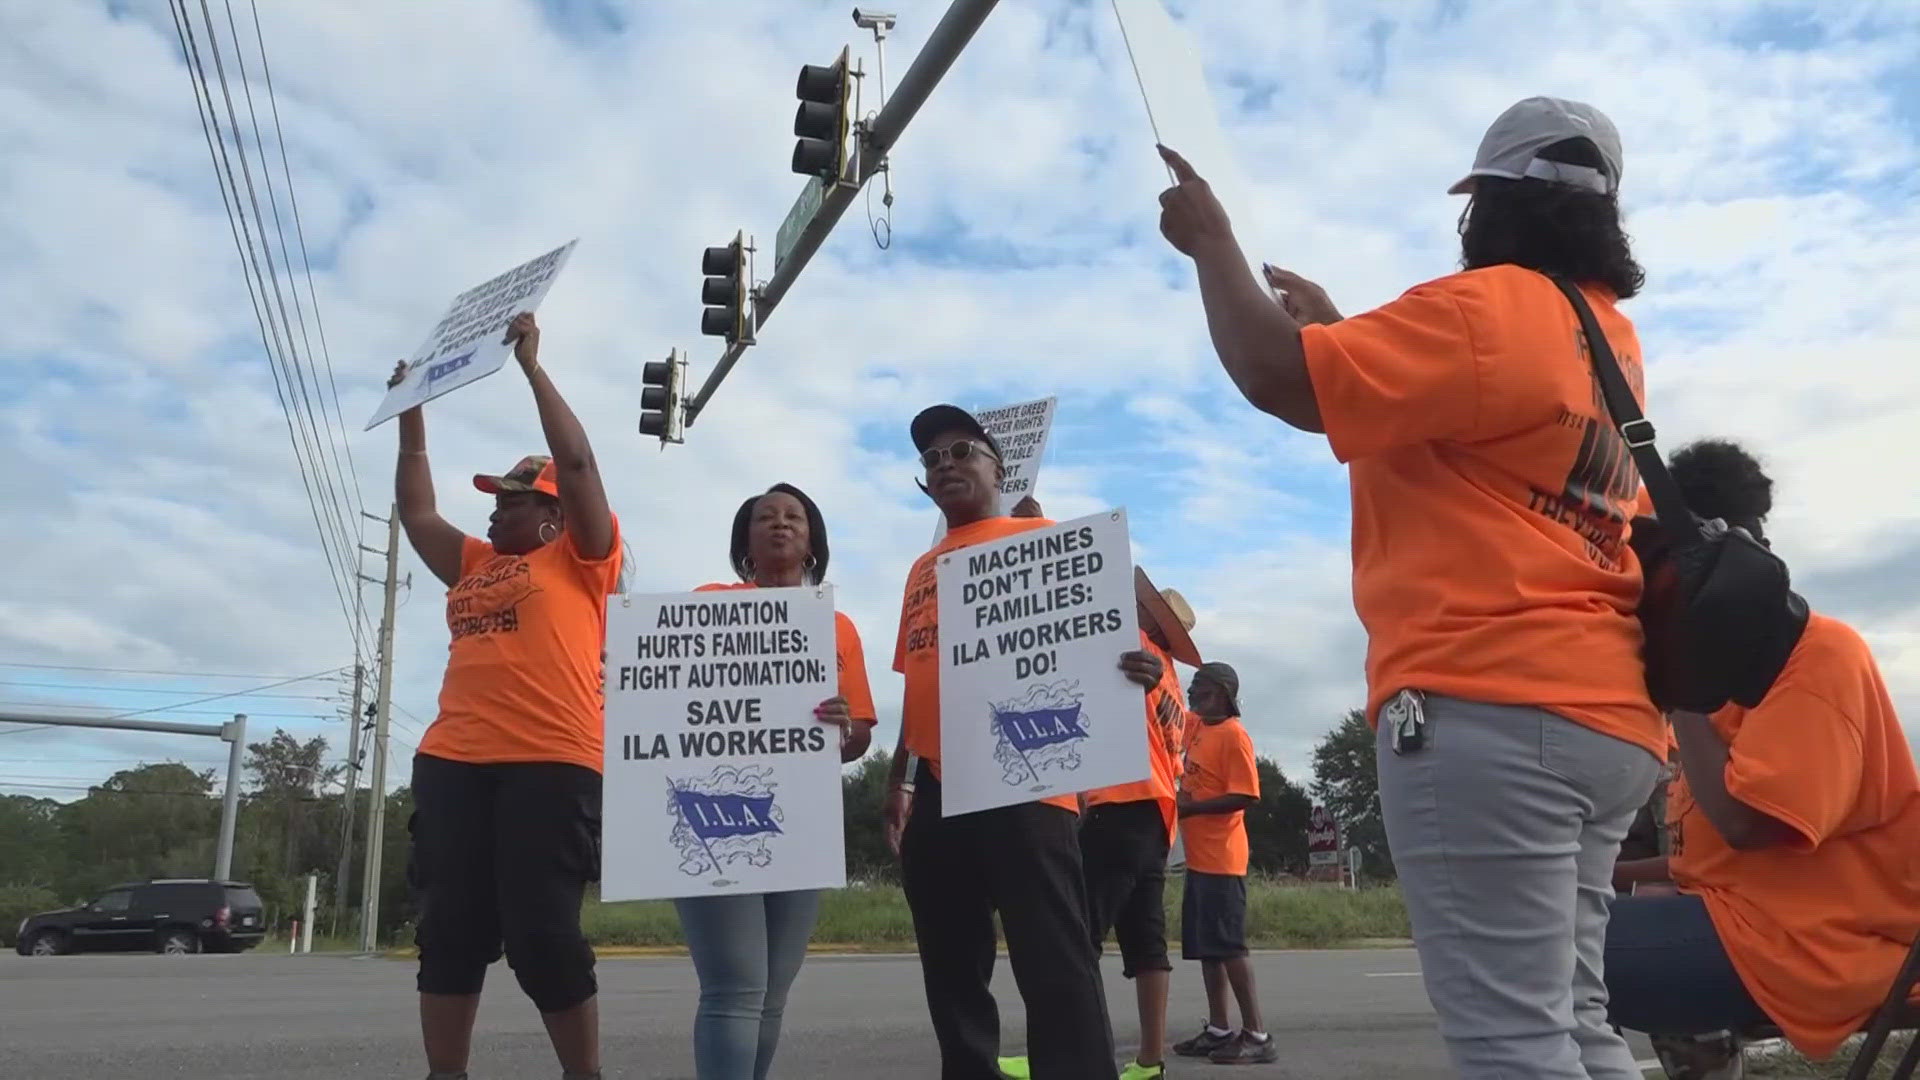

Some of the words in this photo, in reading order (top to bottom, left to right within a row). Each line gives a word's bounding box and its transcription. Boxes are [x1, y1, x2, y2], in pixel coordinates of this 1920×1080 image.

[1021, 401, 1048, 417] GREED
[1013, 431, 1043, 446] PEOPLE
[969, 526, 1094, 577] MACHINES
[963, 568, 1033, 605] DON'T
[1042, 552, 1103, 586] FEED
[657, 600, 788, 628] AUTOMATION
[976, 583, 1093, 629] FAMILIES:
[637, 633, 706, 660] HURTS
[712, 629, 808, 657] FAMILIES:
[953, 638, 990, 666] ILA
[997, 608, 1122, 655] WORKERS
[620, 664, 681, 690] FIGHT
[688, 659, 826, 689] AUTOMATION:
[1016, 650, 1057, 680] DO!
[687, 699, 761, 726] SAVE
[1012, 715, 1077, 741] I.L.A.
[623, 734, 670, 760] ILA
[679, 727, 825, 758] WORKERS
[694, 803, 769, 827] I.L.A.
